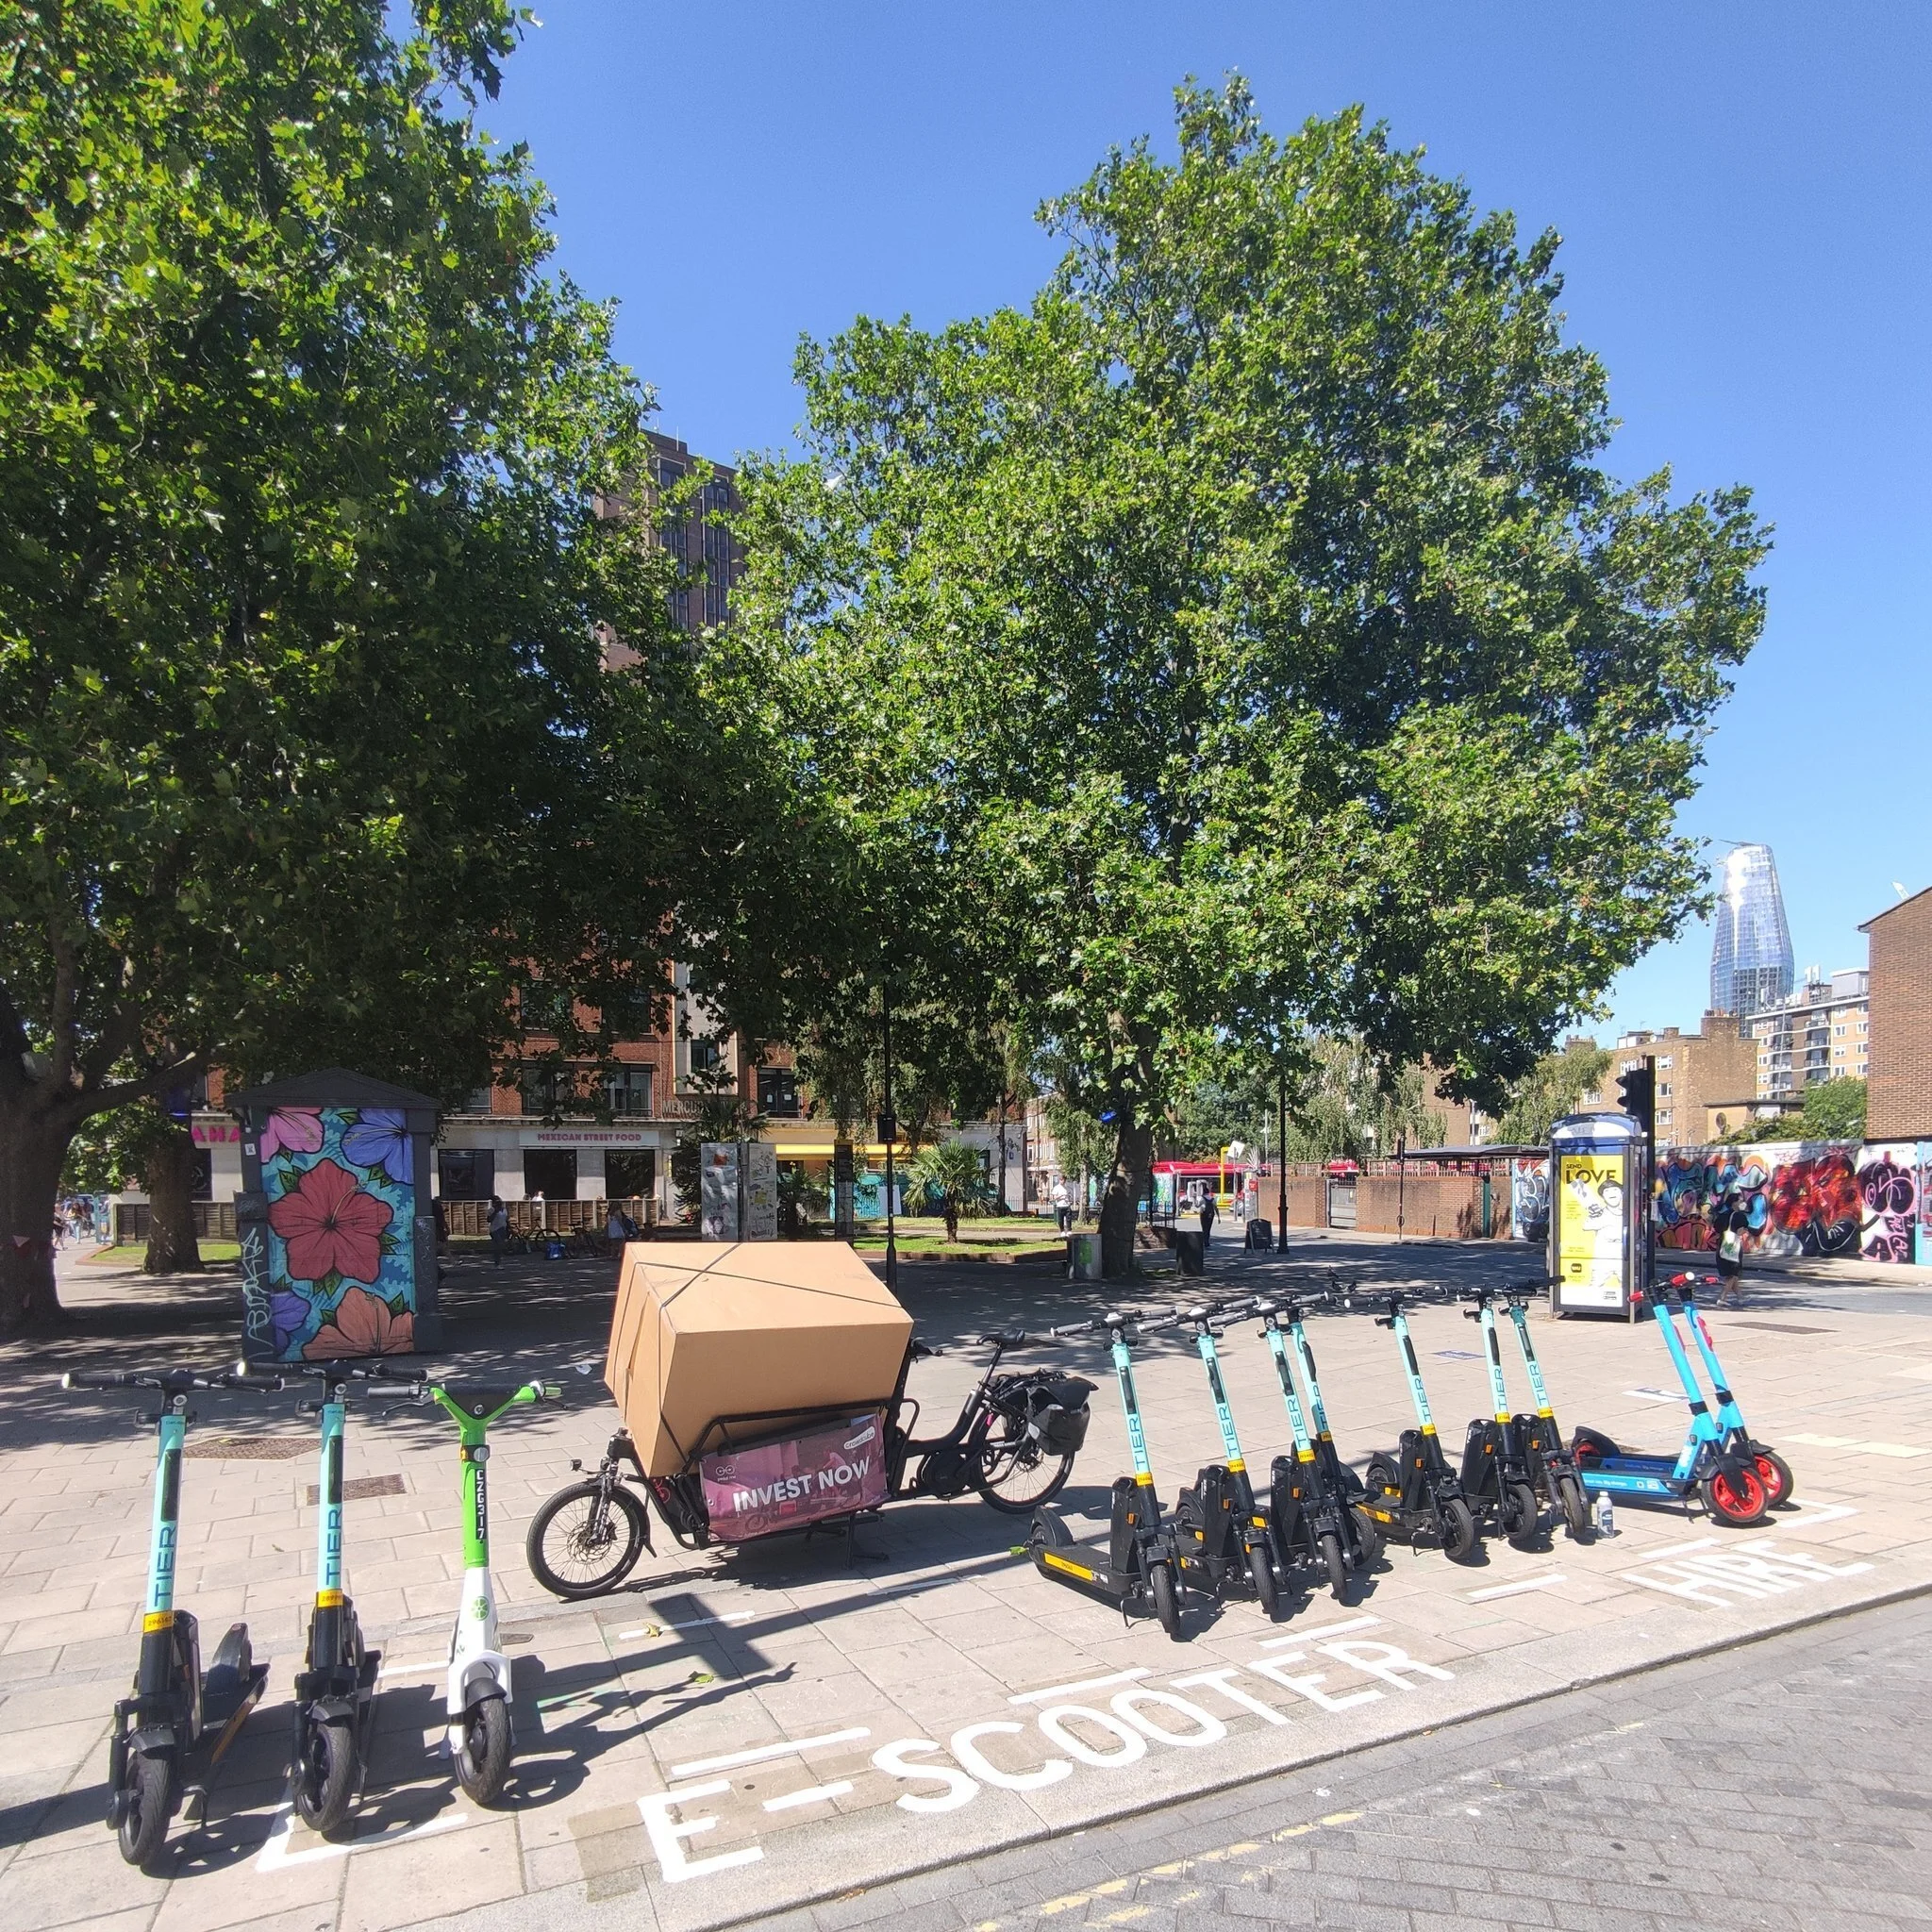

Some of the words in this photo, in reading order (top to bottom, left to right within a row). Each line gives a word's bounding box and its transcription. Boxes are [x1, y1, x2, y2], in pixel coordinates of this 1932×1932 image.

[537, 1133, 582, 1141] MEXICAN
[583, 1133, 613, 1141] STREET
[615, 1133, 641, 1141] FOOD
[1566, 1169, 1617, 1185] LOVE
[1414, 1377, 1431, 1419] TIER
[1493, 1368, 1507, 1410] TIER
[1528, 1364, 1547, 1407] TIER
[1128, 1416, 1146, 1471] TIER
[1218, 1406, 1238, 1457] TIER
[1287, 1397, 1307, 1448] TIER
[732, 1474, 813, 1512] INVEST
[817, 1456, 871, 1491] NOW
[154, 1525, 177, 1607] TIER
[326, 1509, 342, 1586] TIER
[638, 1638, 1456, 1883] E-SCOOTER
[1620, 1539, 1877, 1607] HIRE
